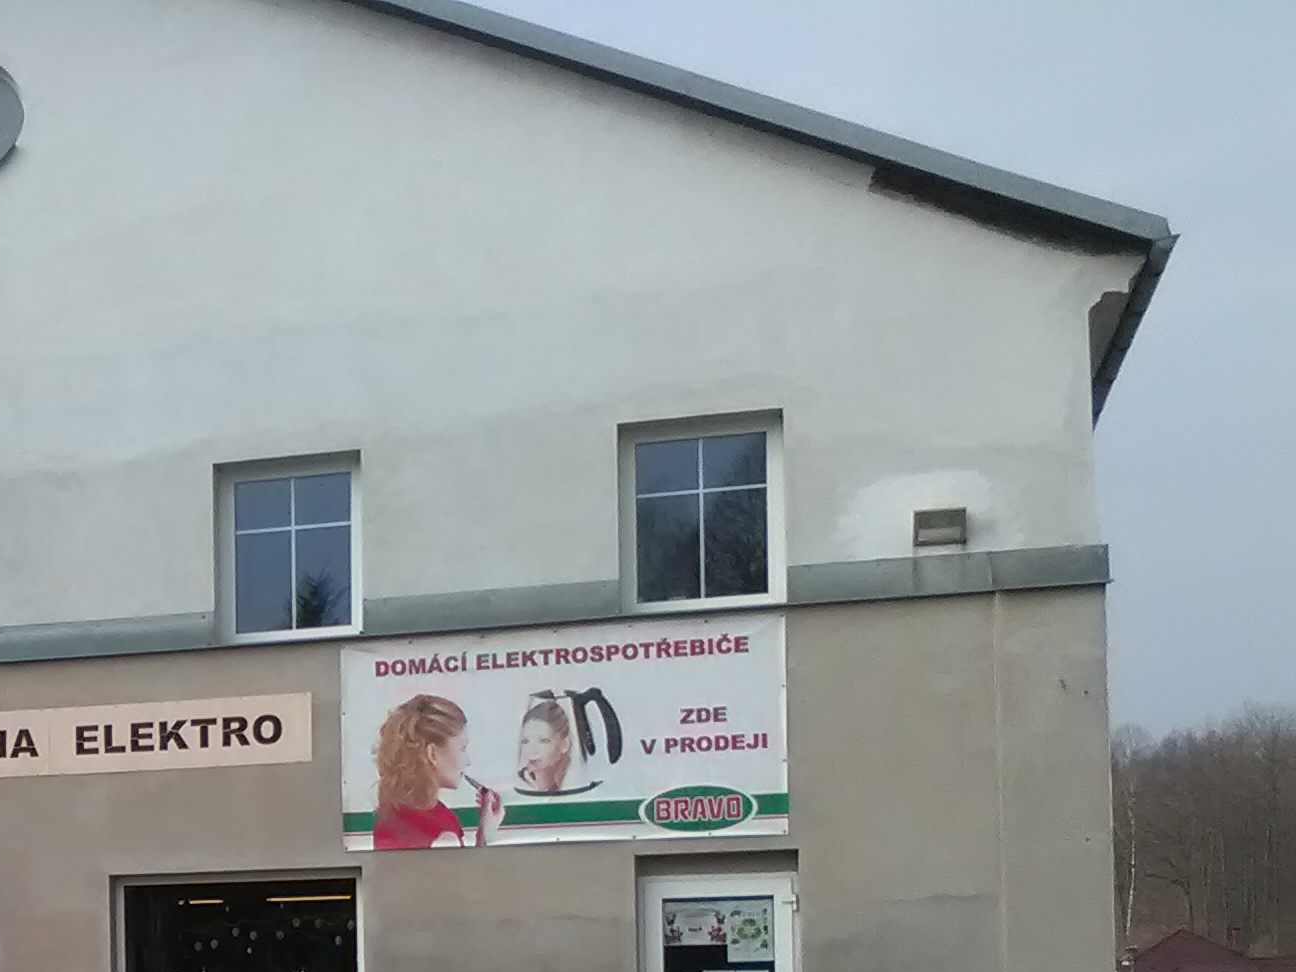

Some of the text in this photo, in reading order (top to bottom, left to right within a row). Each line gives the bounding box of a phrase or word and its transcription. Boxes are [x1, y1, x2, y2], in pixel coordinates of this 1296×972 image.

[374, 633, 750, 678] DOMÁCÍ ELEKTROSPOTŘEBIČE
[678, 706, 728, 725] ZDE
[74, 714, 283, 756] ELEKTRO
[639, 732, 769, 756] V PRODEJI
[653, 794, 744, 823] BRAVO
